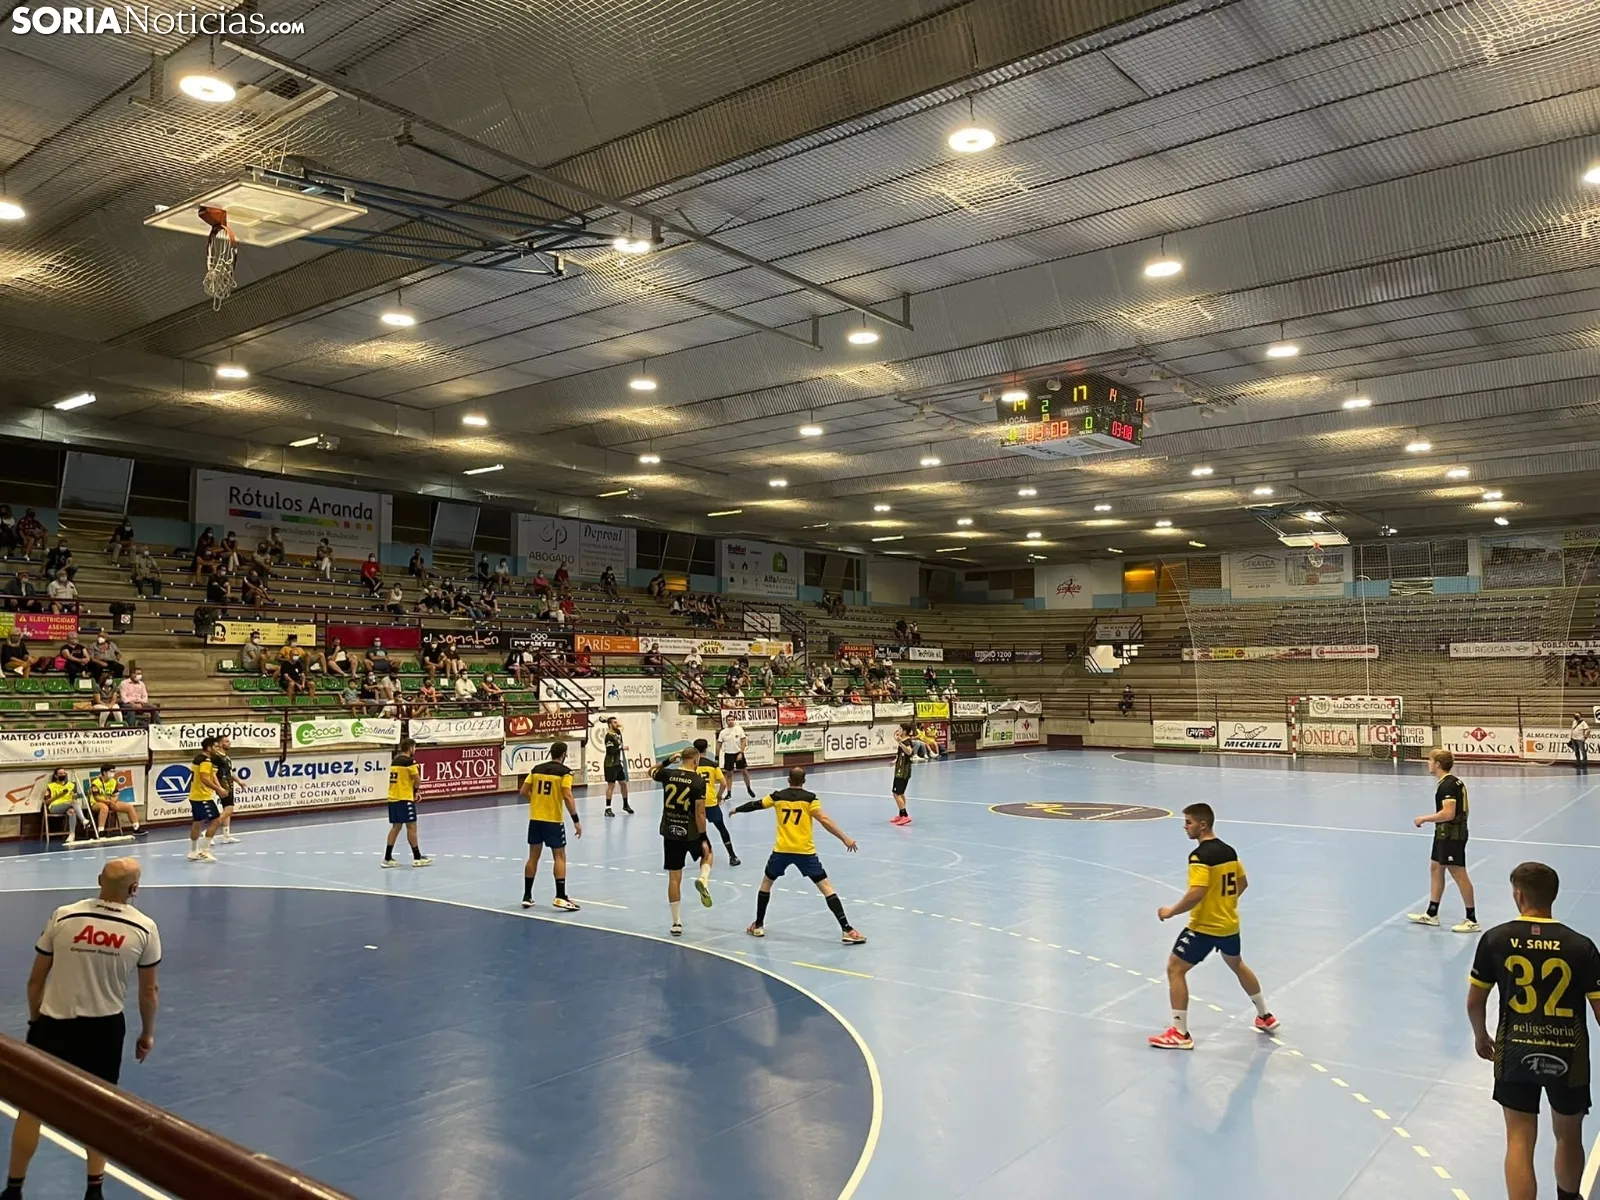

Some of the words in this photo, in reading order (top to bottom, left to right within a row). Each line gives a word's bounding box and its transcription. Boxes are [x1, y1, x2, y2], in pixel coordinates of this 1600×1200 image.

[1073, 385, 1087, 402] 17
[1041, 400, 1049, 412] 2
[1004, 415, 1029, 426] LOCAL
[1085, 416, 1093, 429] 0
[1026, 420, 1069, 441] 03:08
[228, 486, 303, 512] Rótulos
[309, 497, 373, 520] Aranda
[245, 522, 269, 532] Centro
[271, 525, 315, 538] Epecializada
[528, 551, 575, 564] ABOGADO
[29, 615, 76, 623] ELECTRICIDAD
[423, 633, 432, 643] el
[439, 630, 499, 646] somatén
[577, 634, 610, 651] PARÍS
[703, 646, 719, 654] SANZ
[1463, 646, 1511, 654] BURGOCAR
[547, 712, 572, 720] LUCIO
[748, 709, 777, 721] SILVIANO
[435, 722, 452, 732] LA
[455, 718, 501, 732] GOLETA
[951, 722, 981, 734] NABAL
[1, 733, 41, 741] MATEOS
[44, 732, 80, 740] CUESTA
[92, 729, 147, 739] ASOCIADOS
[180, 724, 276, 740] federópticos
[180, 740, 201, 748] Mari
[1224, 741, 1281, 749] MICHELIN
[1444, 743, 1515, 754] TUDANCA
[462, 748, 493, 758] MESON
[364, 761, 386, 772] S.L.
[419, 763, 430, 781] L
[436, 759, 497, 781] PASTOR
[235, 783, 298, 795] SANEAMIENTO
[305, 779, 361, 790] CALEFACCIÓN
[537, 780, 552, 795] 19
[234, 791, 280, 803] BILIARIO
[284, 792, 297, 800] DE
[300, 789, 338, 799] COCINA
[340, 788, 345, 796] Y
[348, 785, 374, 794] BAÑO
[665, 783, 691, 811] 24
[153, 808, 160, 816] C/
[160, 808, 178, 817] Puerta
[238, 802, 264, 810] ARANDA
[782, 808, 803, 826] 77
[1221, 872, 1237, 896] 15
[1510, 938, 1522, 949] V.
[1527, 939, 1561, 951] SANZ
[1504, 954, 1574, 1018] 32
[1513, 1021, 1575, 1037] #eligeSoria
